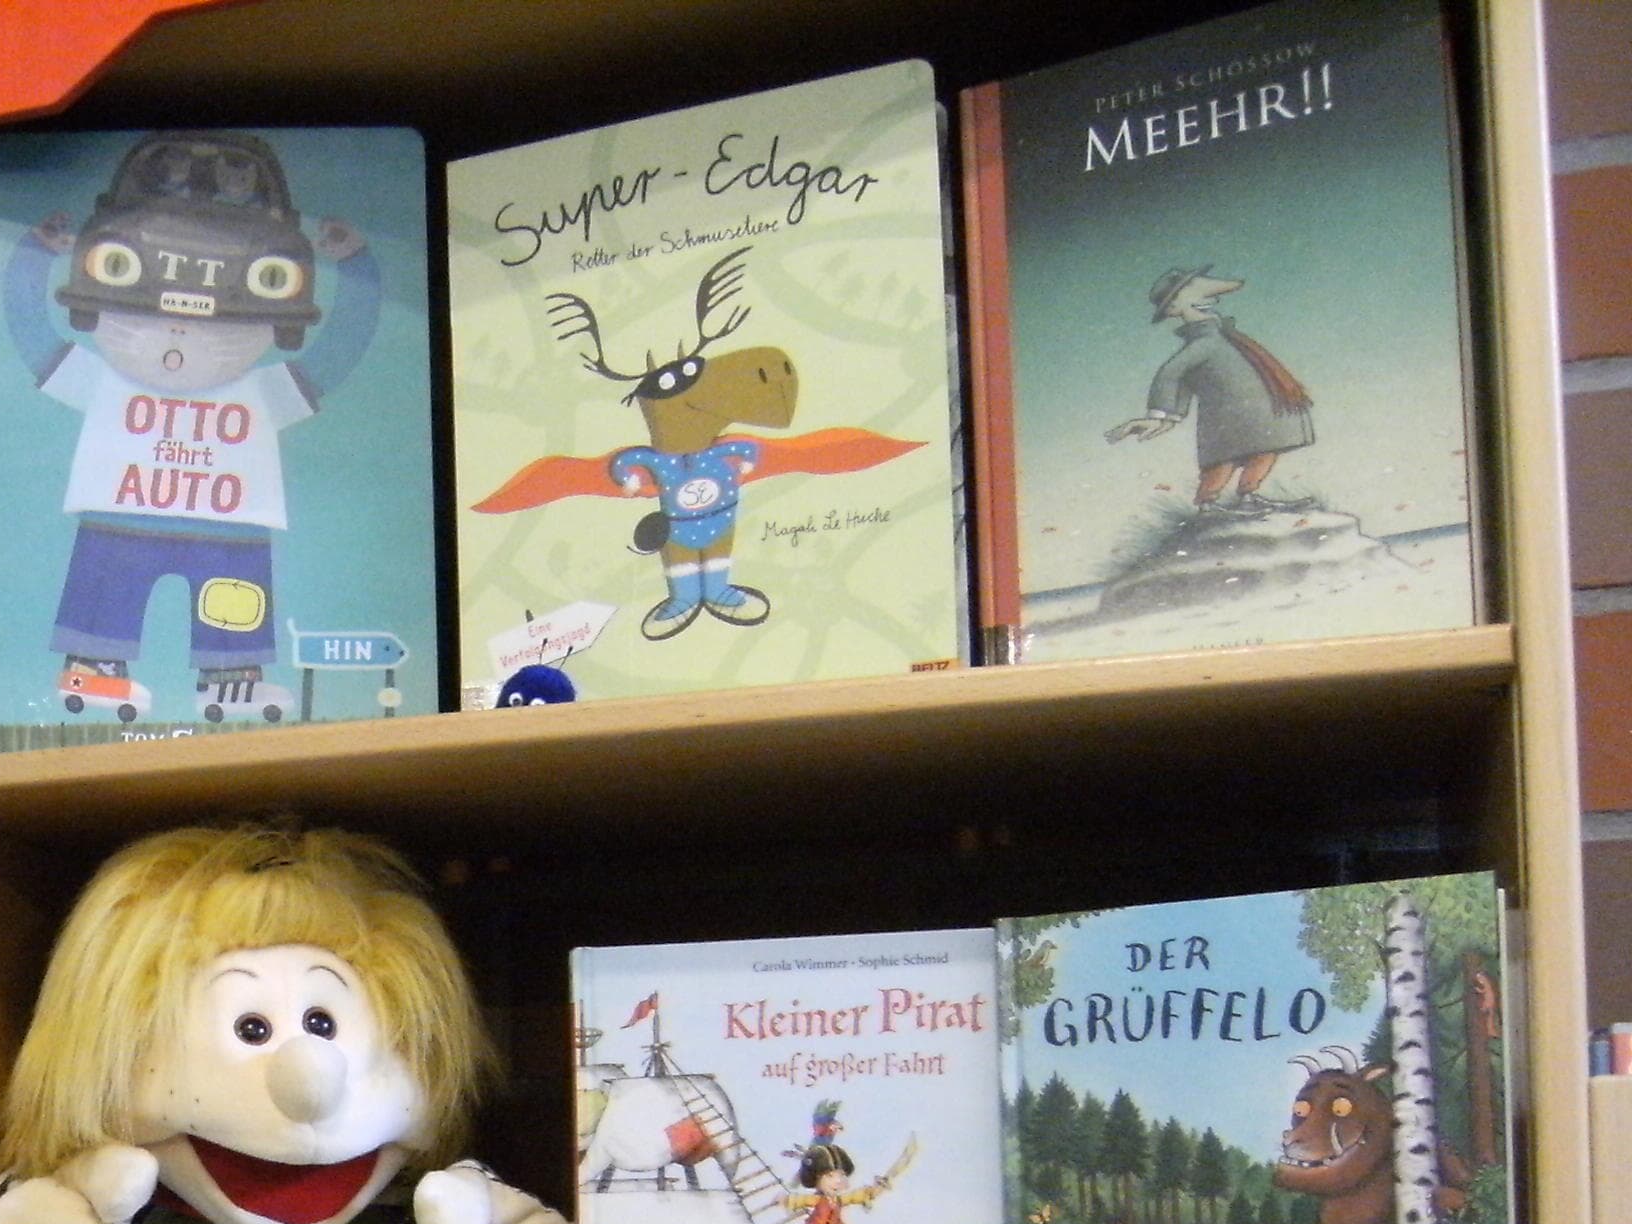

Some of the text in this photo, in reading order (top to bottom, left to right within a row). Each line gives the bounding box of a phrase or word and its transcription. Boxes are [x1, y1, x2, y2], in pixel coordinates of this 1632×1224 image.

[1083, 63, 1334, 173] MEEHR!!
[1095, 81, 1164, 114] PETER
[705, 133, 879, 225] Edgar
[625, 243, 654, 260] der
[125, 394, 251, 445] OTTO
[152, 439, 214, 467] fährt
[115, 463, 243, 514] AUTO
[323, 639, 373, 661] HIN
[1125, 936, 1210, 973] DER
[723, 987, 987, 1041] Kleiner Pirat
[1043, 986, 1327, 1047] GRÜFFELO
[761, 1051, 947, 1088] auf großer Fahrt
